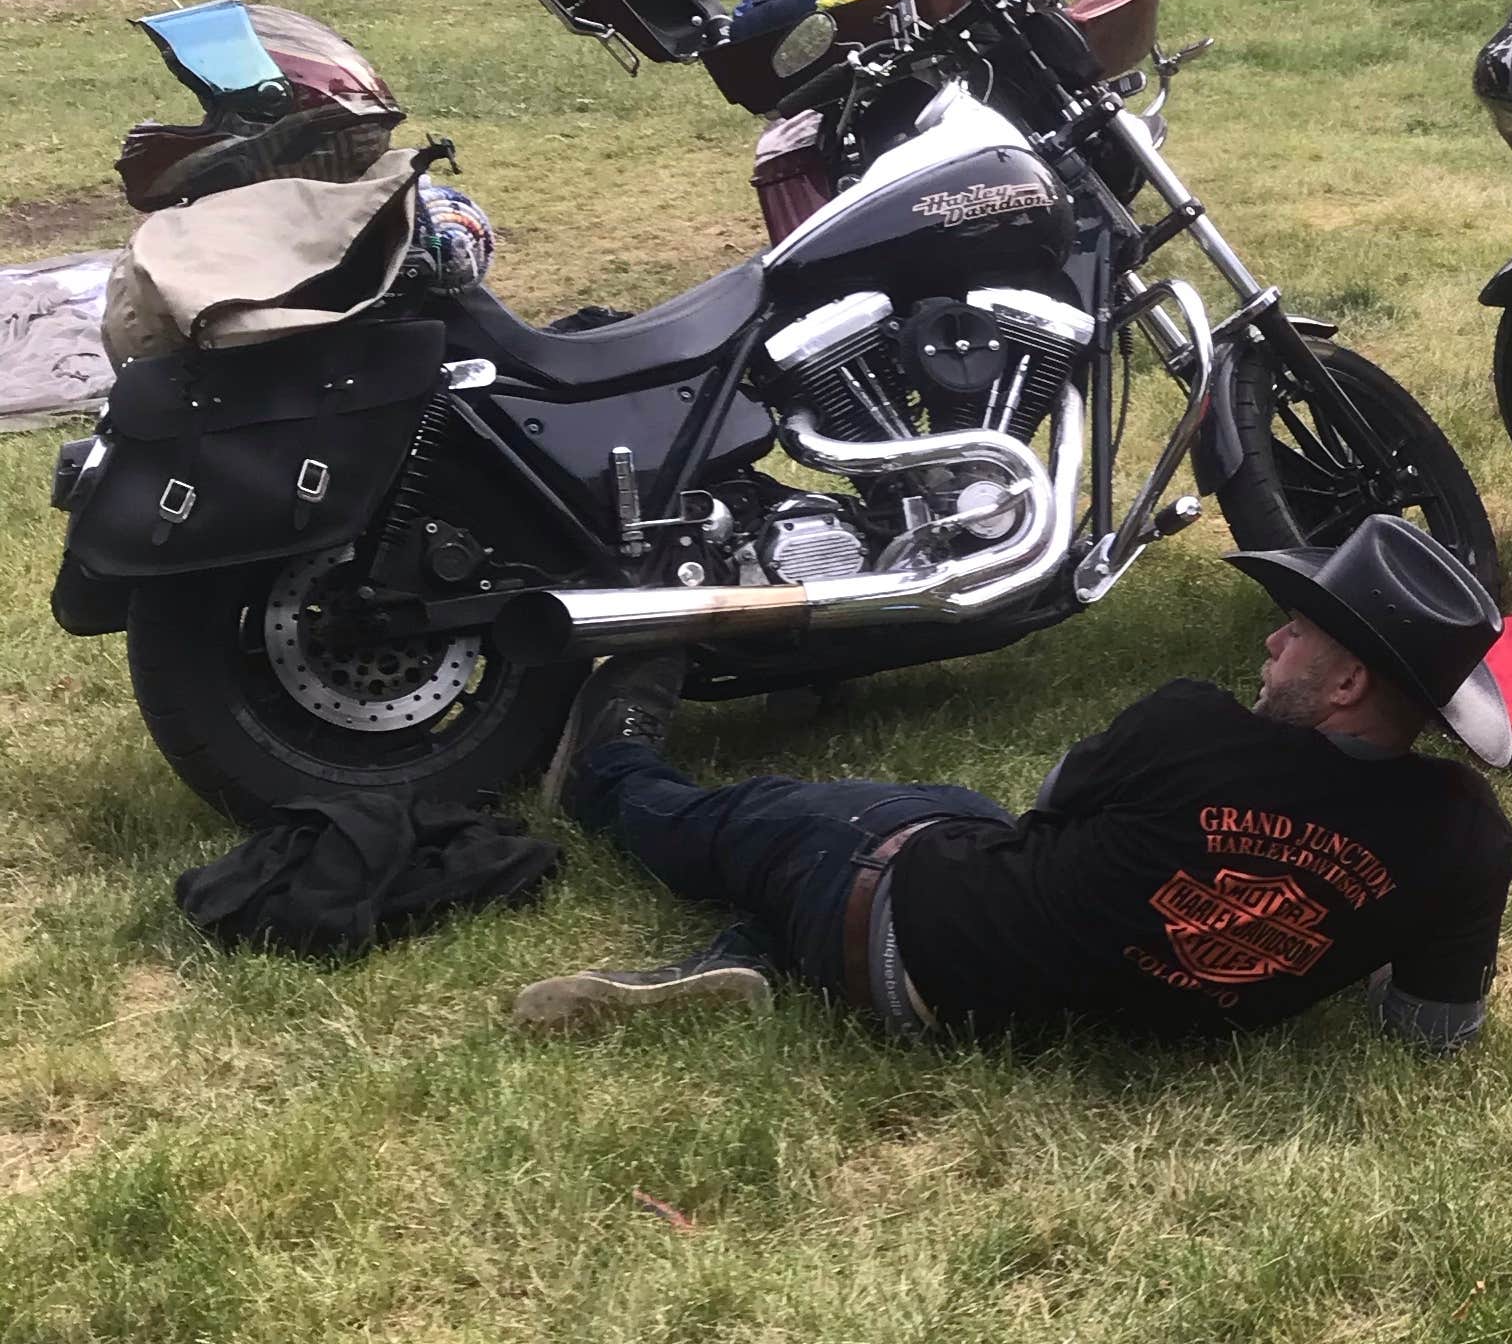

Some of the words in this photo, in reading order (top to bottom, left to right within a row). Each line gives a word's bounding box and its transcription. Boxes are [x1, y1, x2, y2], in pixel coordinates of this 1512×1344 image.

[912, 184, 1040, 215] Harley
[944, 194, 1052, 227] Davidson
[1200, 807, 1292, 839] GRAND
[1296, 822, 1398, 901] JUNCTION
[1230, 887, 1305, 923] MOTOR
